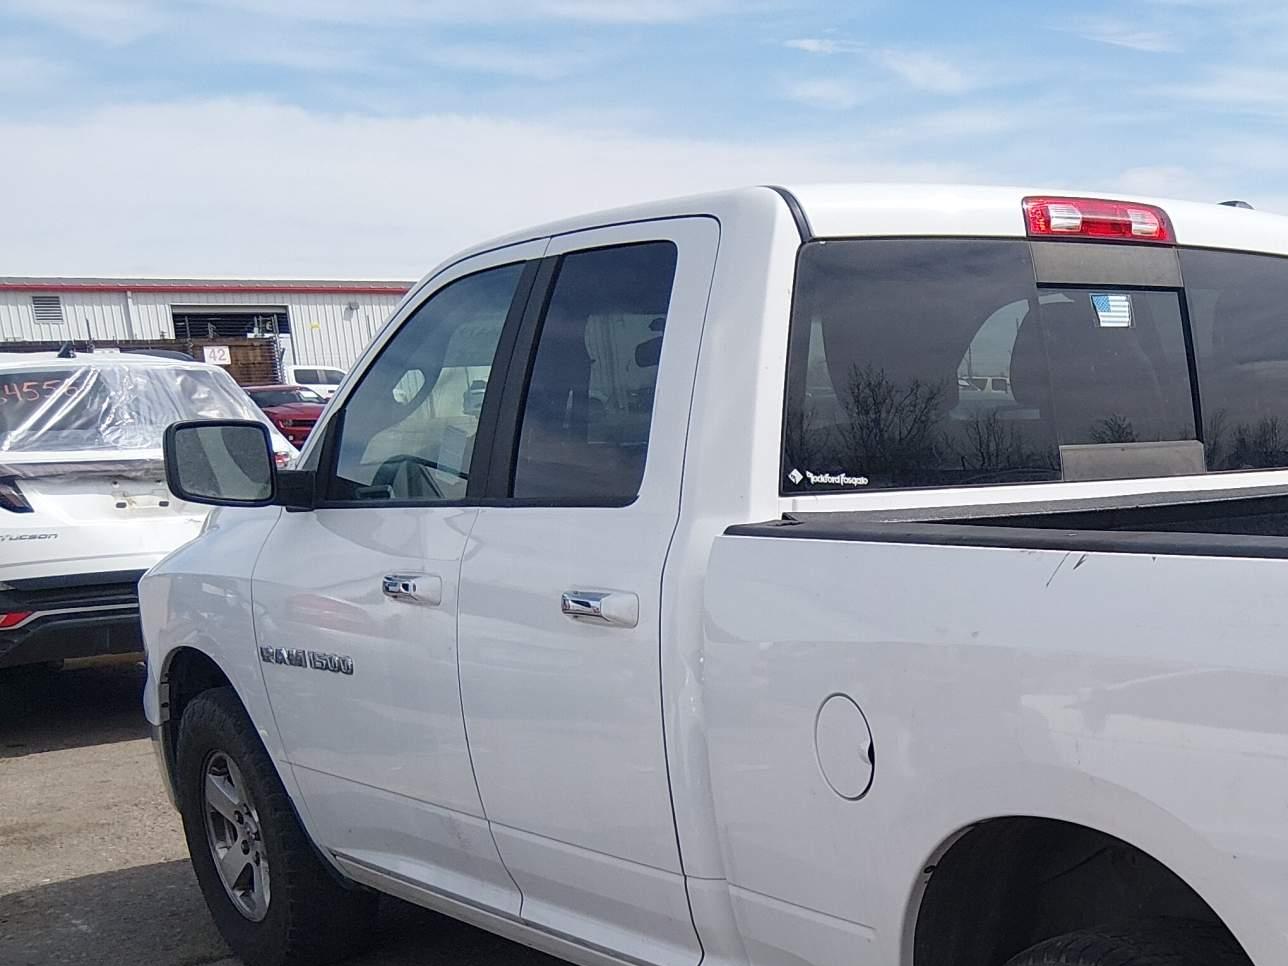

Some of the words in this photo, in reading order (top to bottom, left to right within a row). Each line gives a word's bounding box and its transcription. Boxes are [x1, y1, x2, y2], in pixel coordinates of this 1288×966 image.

[208, 348, 227, 362] 42
[260, 646, 307, 668] RAM
[307, 651, 354, 676] 1500
